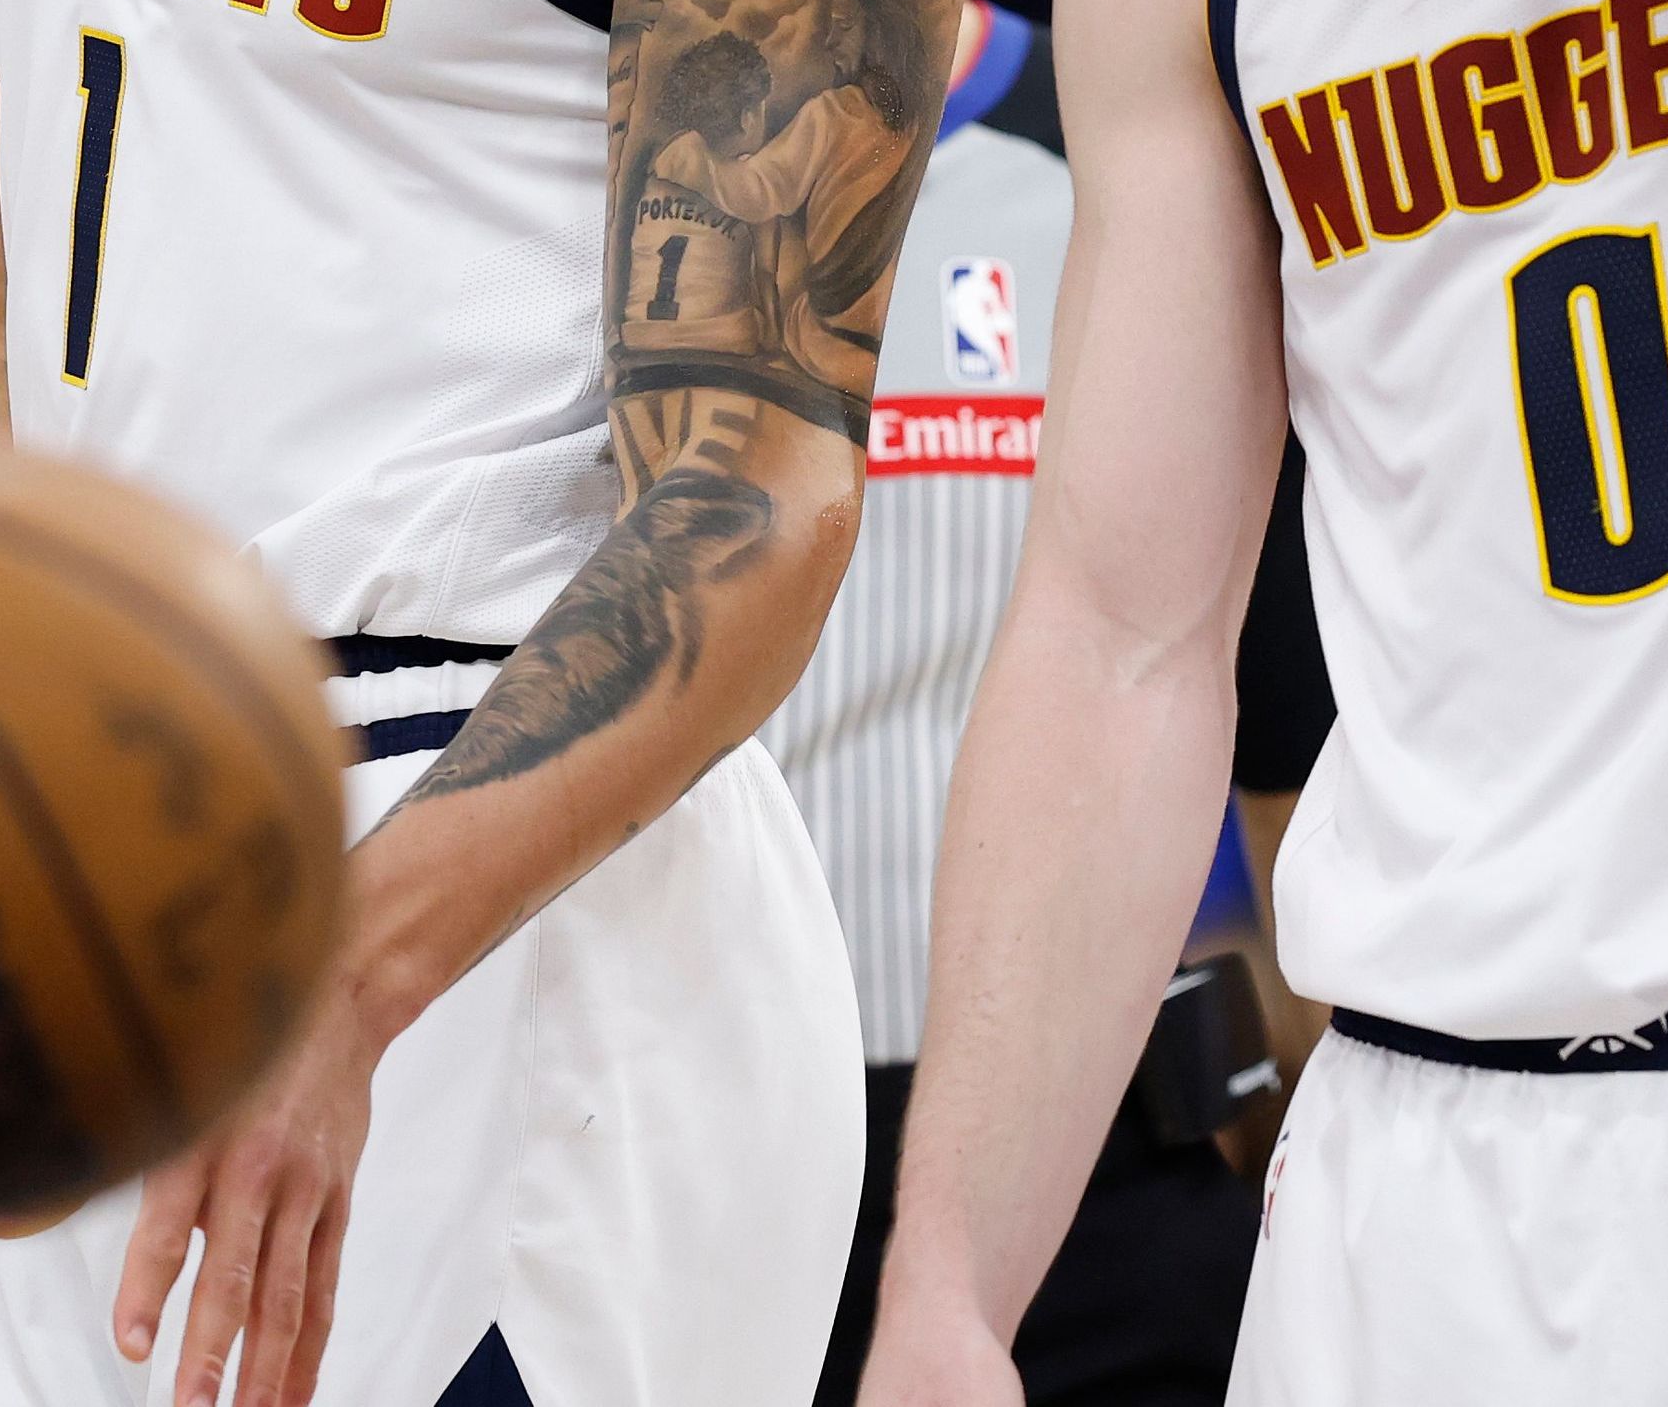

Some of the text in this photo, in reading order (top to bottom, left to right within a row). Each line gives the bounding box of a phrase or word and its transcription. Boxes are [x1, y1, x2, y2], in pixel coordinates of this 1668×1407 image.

[60, 24, 128, 391] 1
[639, 195, 706, 225] PORTER
[646, 235, 689, 320] 1
